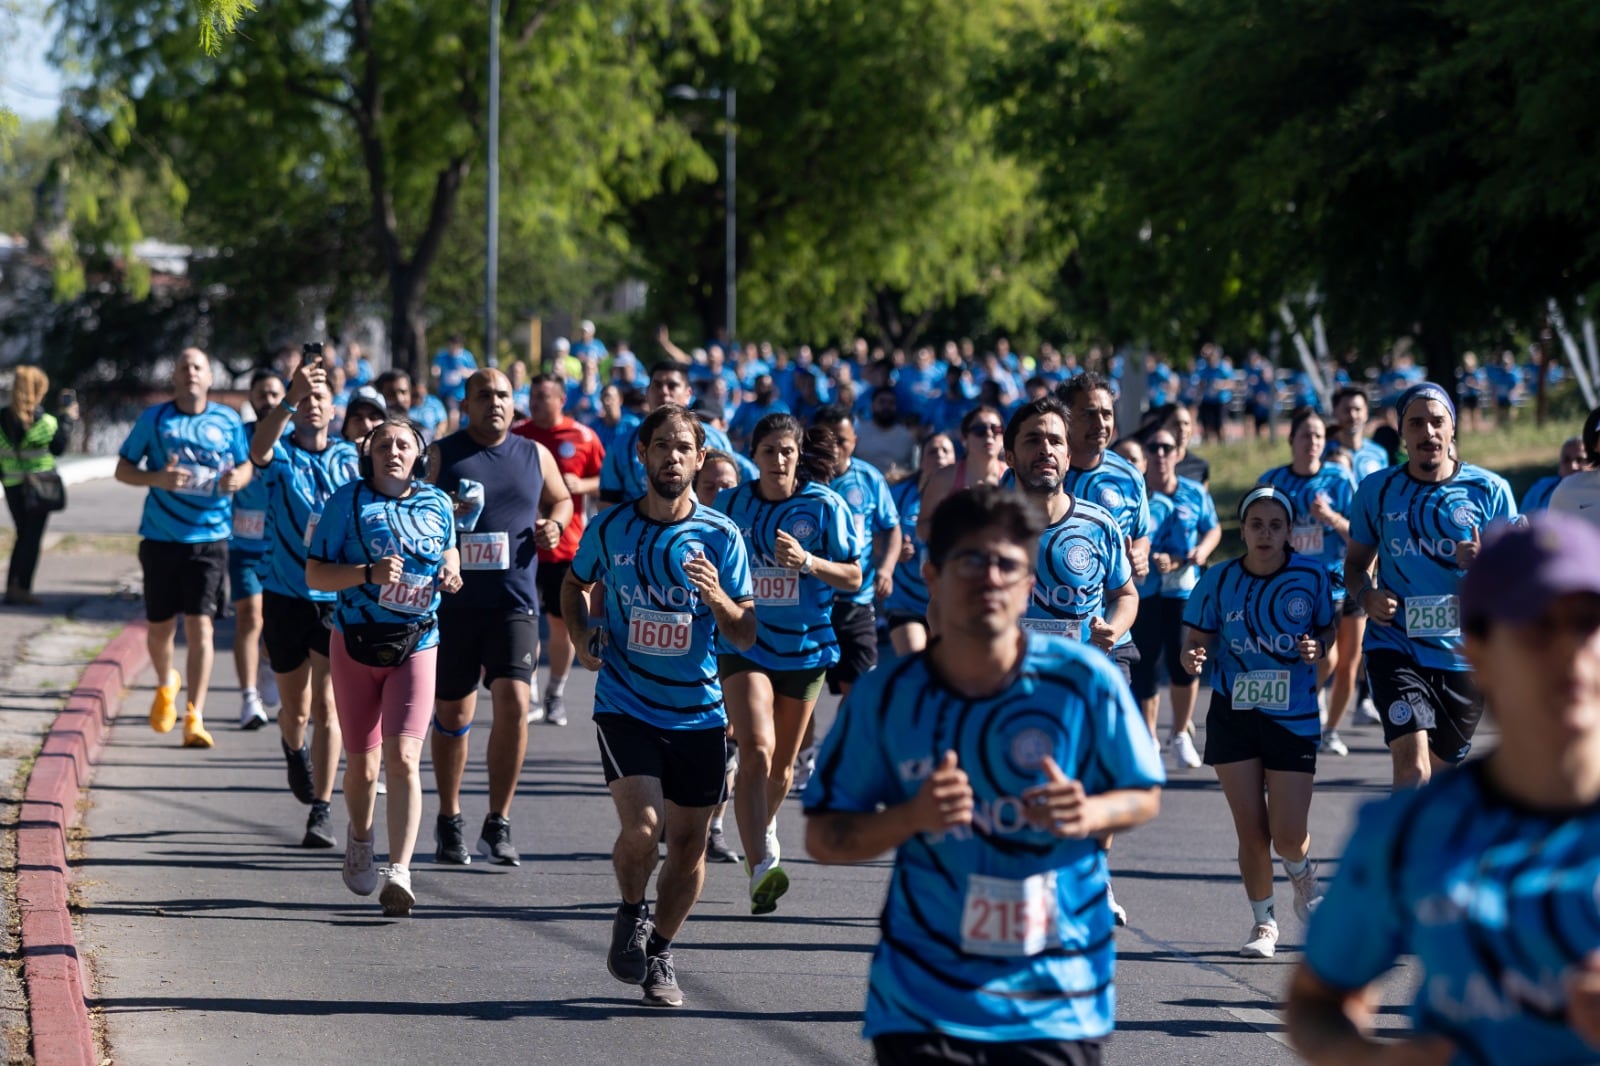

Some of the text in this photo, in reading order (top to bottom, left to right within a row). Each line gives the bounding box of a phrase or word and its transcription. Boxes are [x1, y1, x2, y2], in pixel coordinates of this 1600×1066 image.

[370, 536, 445, 557] SANOS
[464, 543, 504, 563] 1747
[1292, 534, 1322, 550] 076
[1390, 538, 1457, 557] SANO
[381, 582, 432, 608] 2045
[751, 577, 797, 599] 2097
[1031, 584, 1088, 607] NOS
[1408, 606, 1458, 630] 2583
[631, 620, 689, 649] 1609
[1233, 680, 1288, 703] 2640
